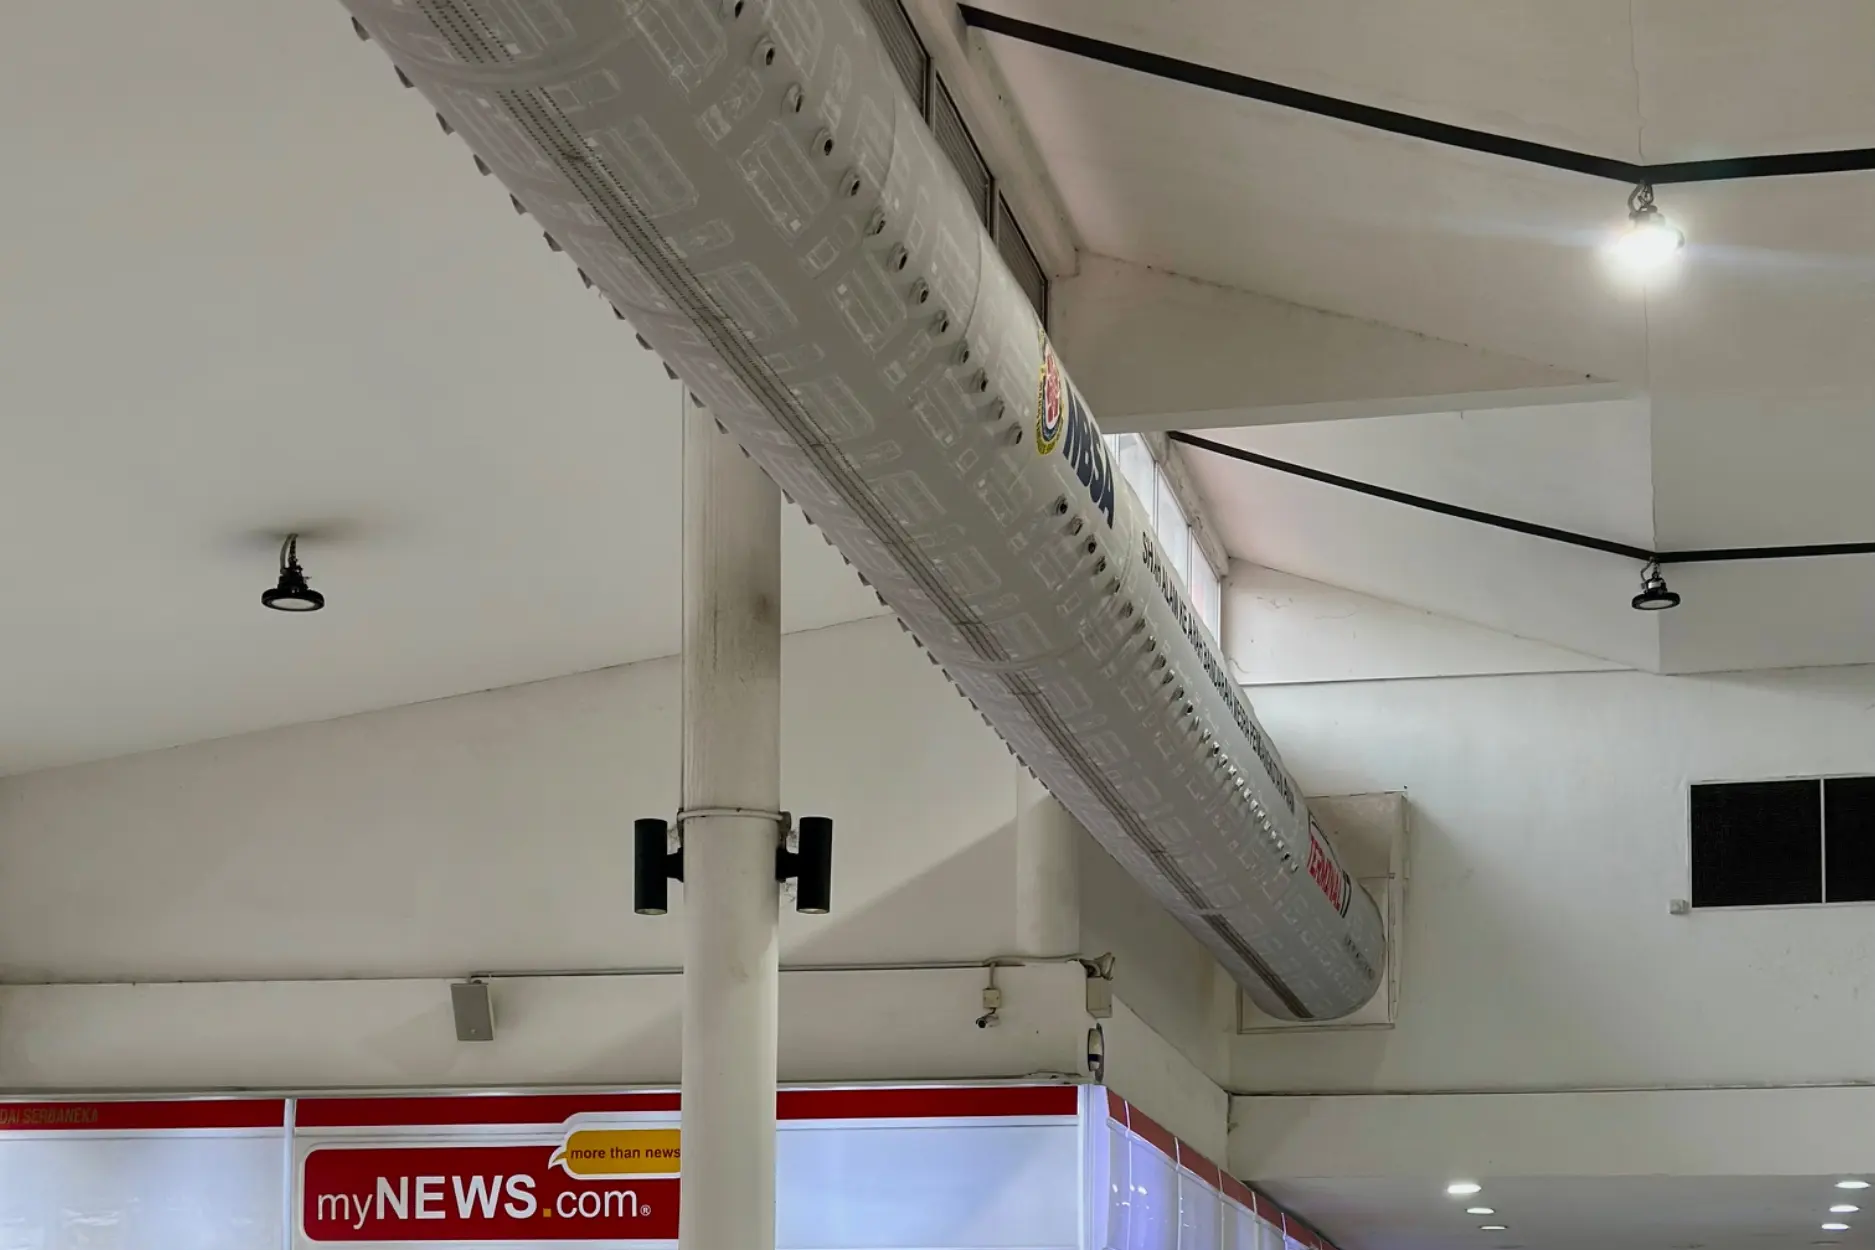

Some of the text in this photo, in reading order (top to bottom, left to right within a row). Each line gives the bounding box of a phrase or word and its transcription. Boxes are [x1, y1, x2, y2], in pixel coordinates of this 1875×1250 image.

[1062, 376, 1115, 530] MBSA
[571, 1147, 681, 1159] more than news
